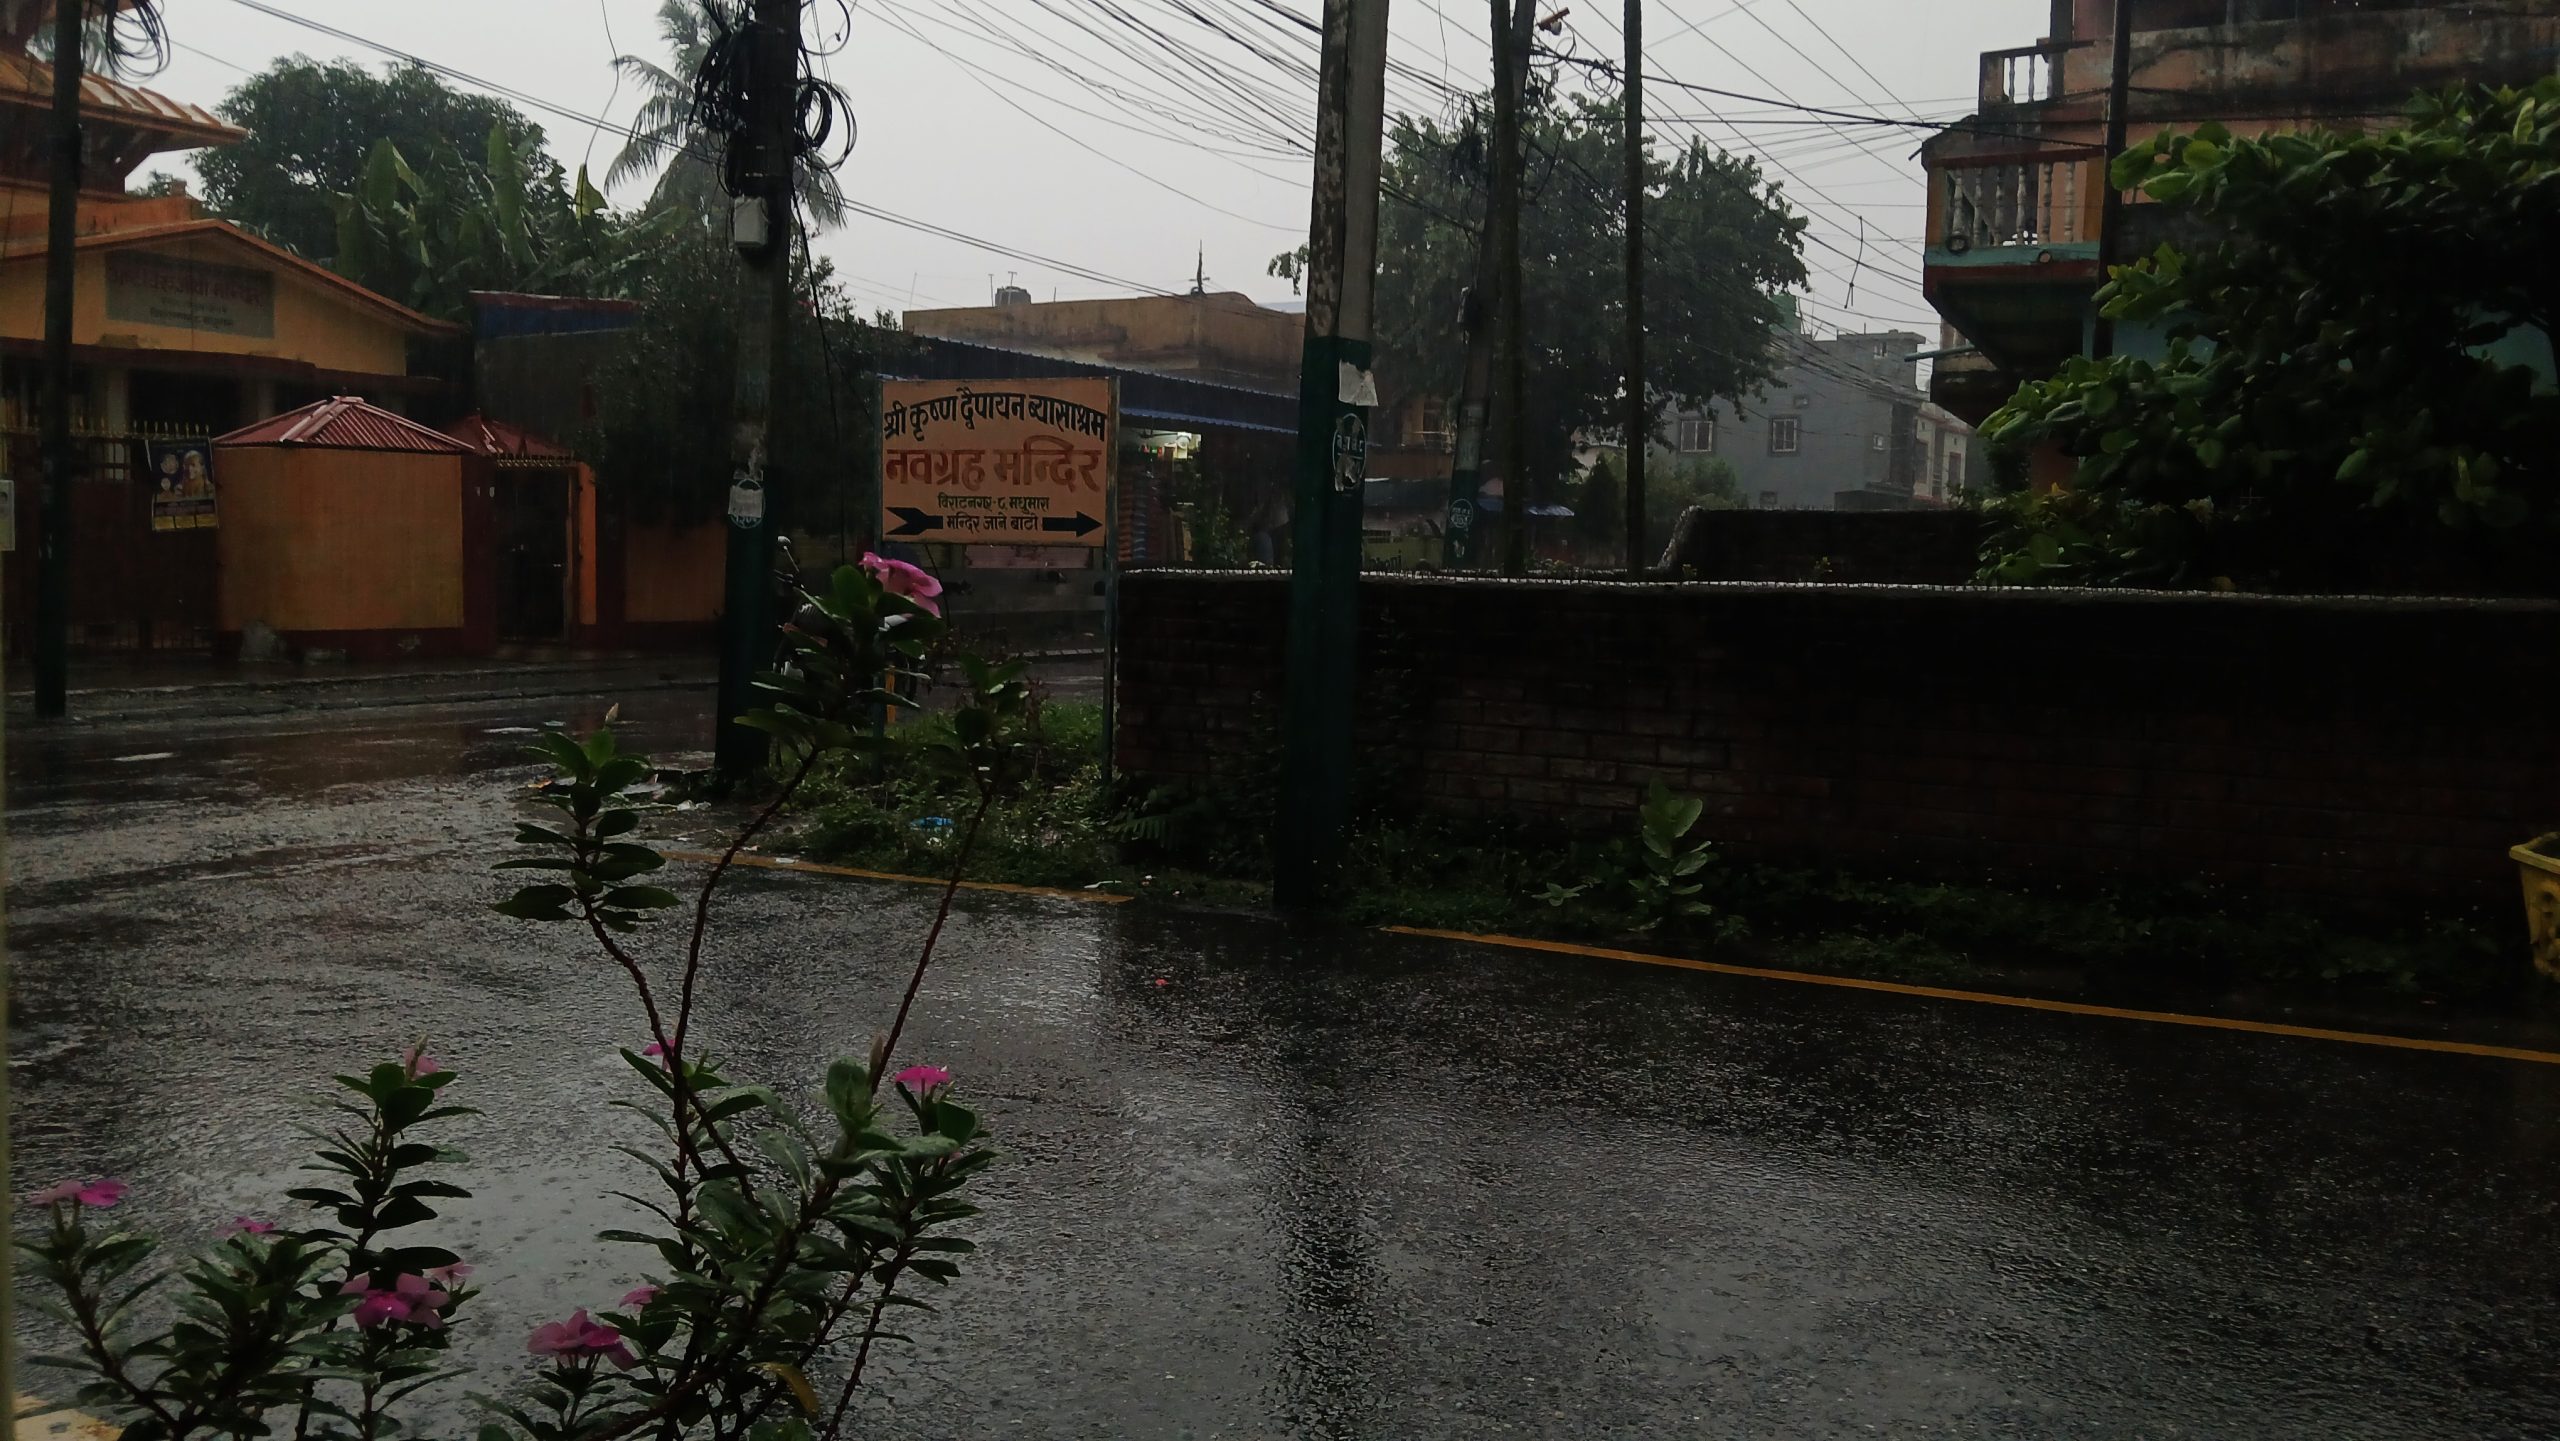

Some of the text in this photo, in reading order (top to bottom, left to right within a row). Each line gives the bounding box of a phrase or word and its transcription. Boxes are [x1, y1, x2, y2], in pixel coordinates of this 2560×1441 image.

[883, 400, 908, 441] श्री
[910, 396, 959, 442] कृष्ण
[886, 434, 1103, 493] नवग्रह मन्दिर
[946, 511, 980, 534] मन्दिर
[983, 511, 1007, 531] जाने
